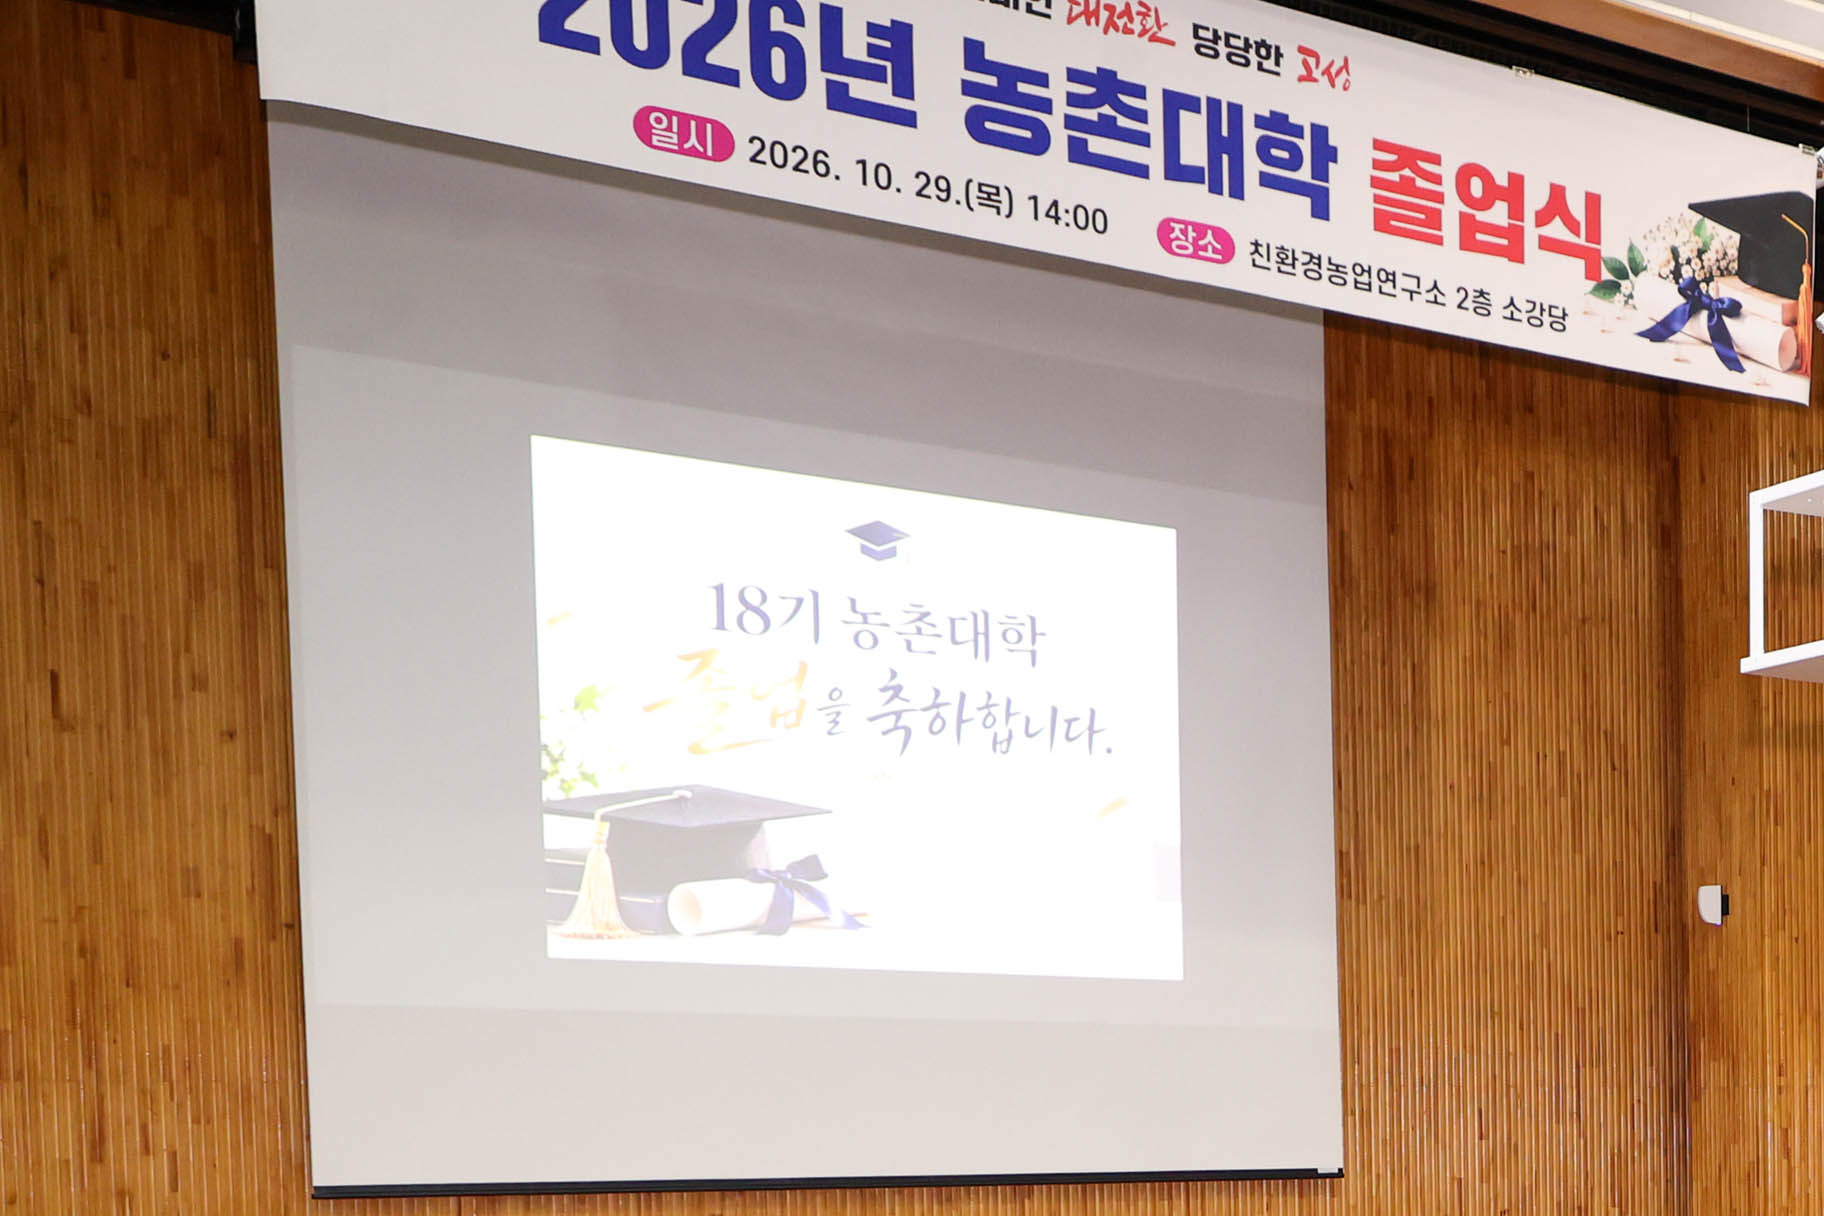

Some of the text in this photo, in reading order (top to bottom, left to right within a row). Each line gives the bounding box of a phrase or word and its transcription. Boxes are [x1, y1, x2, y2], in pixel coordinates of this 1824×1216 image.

[1066, 0, 1178, 47] 대전환
[1191, 22, 1285, 77] 당당한
[1297, 44, 1351, 92] 고성
[649, 111, 1109, 235] 일시 2026. 10. 29.(목) 14:00
[961, 36, 1338, 221] 농촌대학
[1370, 137, 1602, 283] 졸업식
[1169, 222, 1570, 333] 장소 친환경농업연구소 2층 소강당
[708, 583, 1048, 667] 18기 농촌대학
[867, 667, 1113, 756] 축하합니다.
